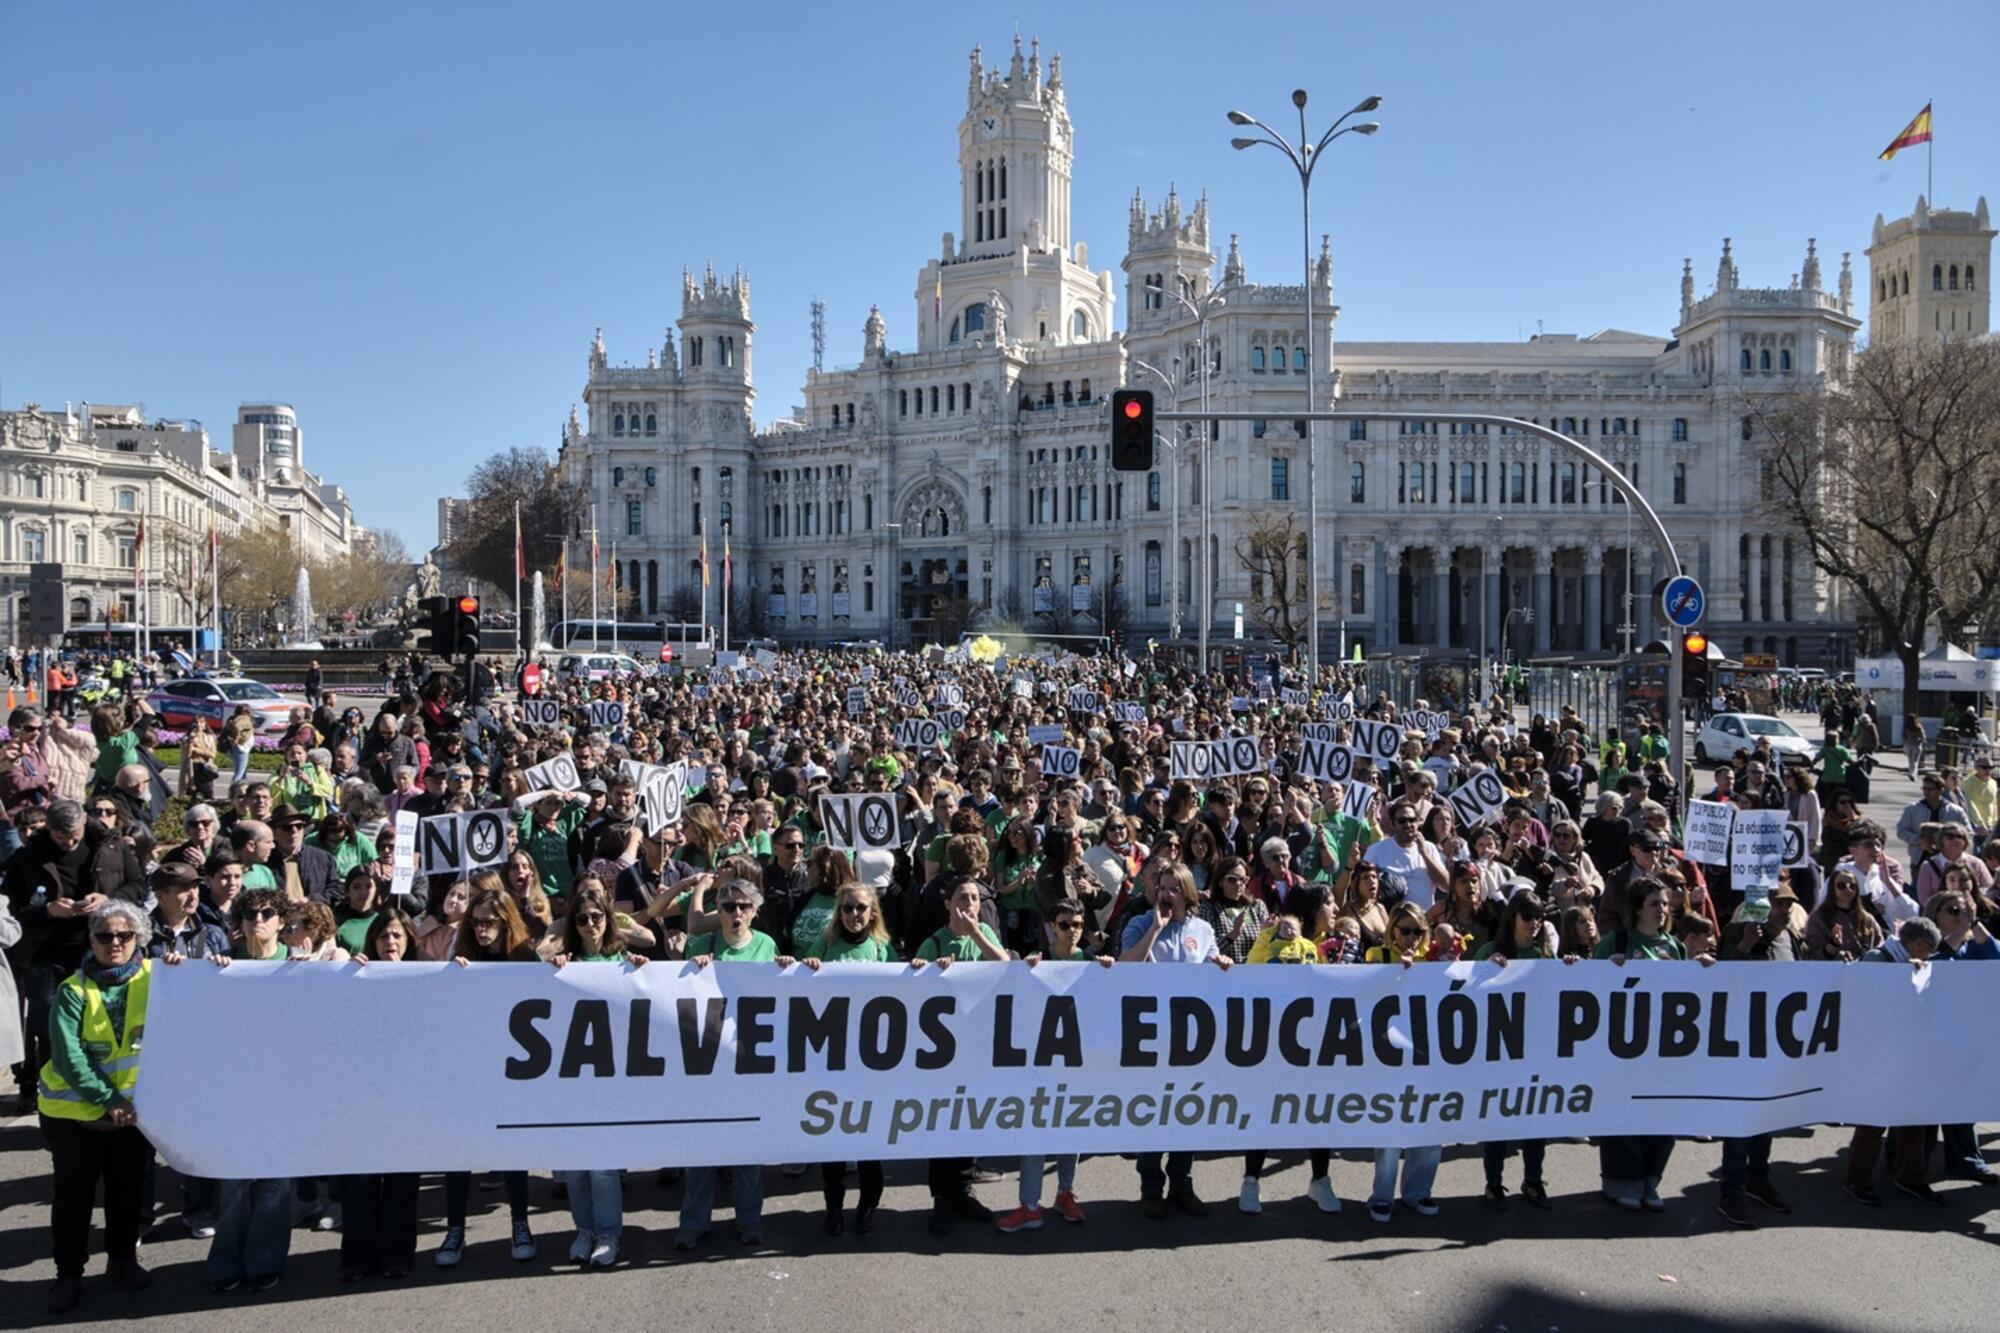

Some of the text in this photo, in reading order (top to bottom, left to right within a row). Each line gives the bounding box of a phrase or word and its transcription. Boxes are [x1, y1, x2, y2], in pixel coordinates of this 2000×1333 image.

[711, 671, 728, 685] NO
[897, 687, 920, 706] NO
[938, 686, 962, 705] NO
[1072, 693, 1095, 710] NO
[1289, 692, 1308, 705] NO
[525, 702, 558, 724] NO
[591, 703, 623, 725] NO
[937, 710, 963, 731] NO
[1326, 703, 1351, 720] NO
[1403, 711, 1428, 731] NO
[1430, 713, 1448, 731] NO
[902, 721, 938, 745] NO
[1303, 725, 1331, 742] NO
[1353, 721, 1399, 758] NO
[1043, 749, 1078, 774] NO
[1172, 743, 1210, 776] NO
[1211, 739, 1257, 775] NO
[1301, 740, 1351, 782] NO
[528, 758, 576, 791] NO
[646, 773, 679, 832] NO
[1450, 773, 1503, 824] NO
[821, 796, 895, 847] NO
[1735, 821, 1744, 834] La
[424, 812, 504, 871] NO
[1737, 844, 1747, 854] un
[1734, 863, 1745, 875] no
[505, 976, 1842, 1081] SALVEMOS LA EDUCACIÓN PÚBLICA
[800, 1080, 1594, 1145] Su privatización, nuestra ruina
